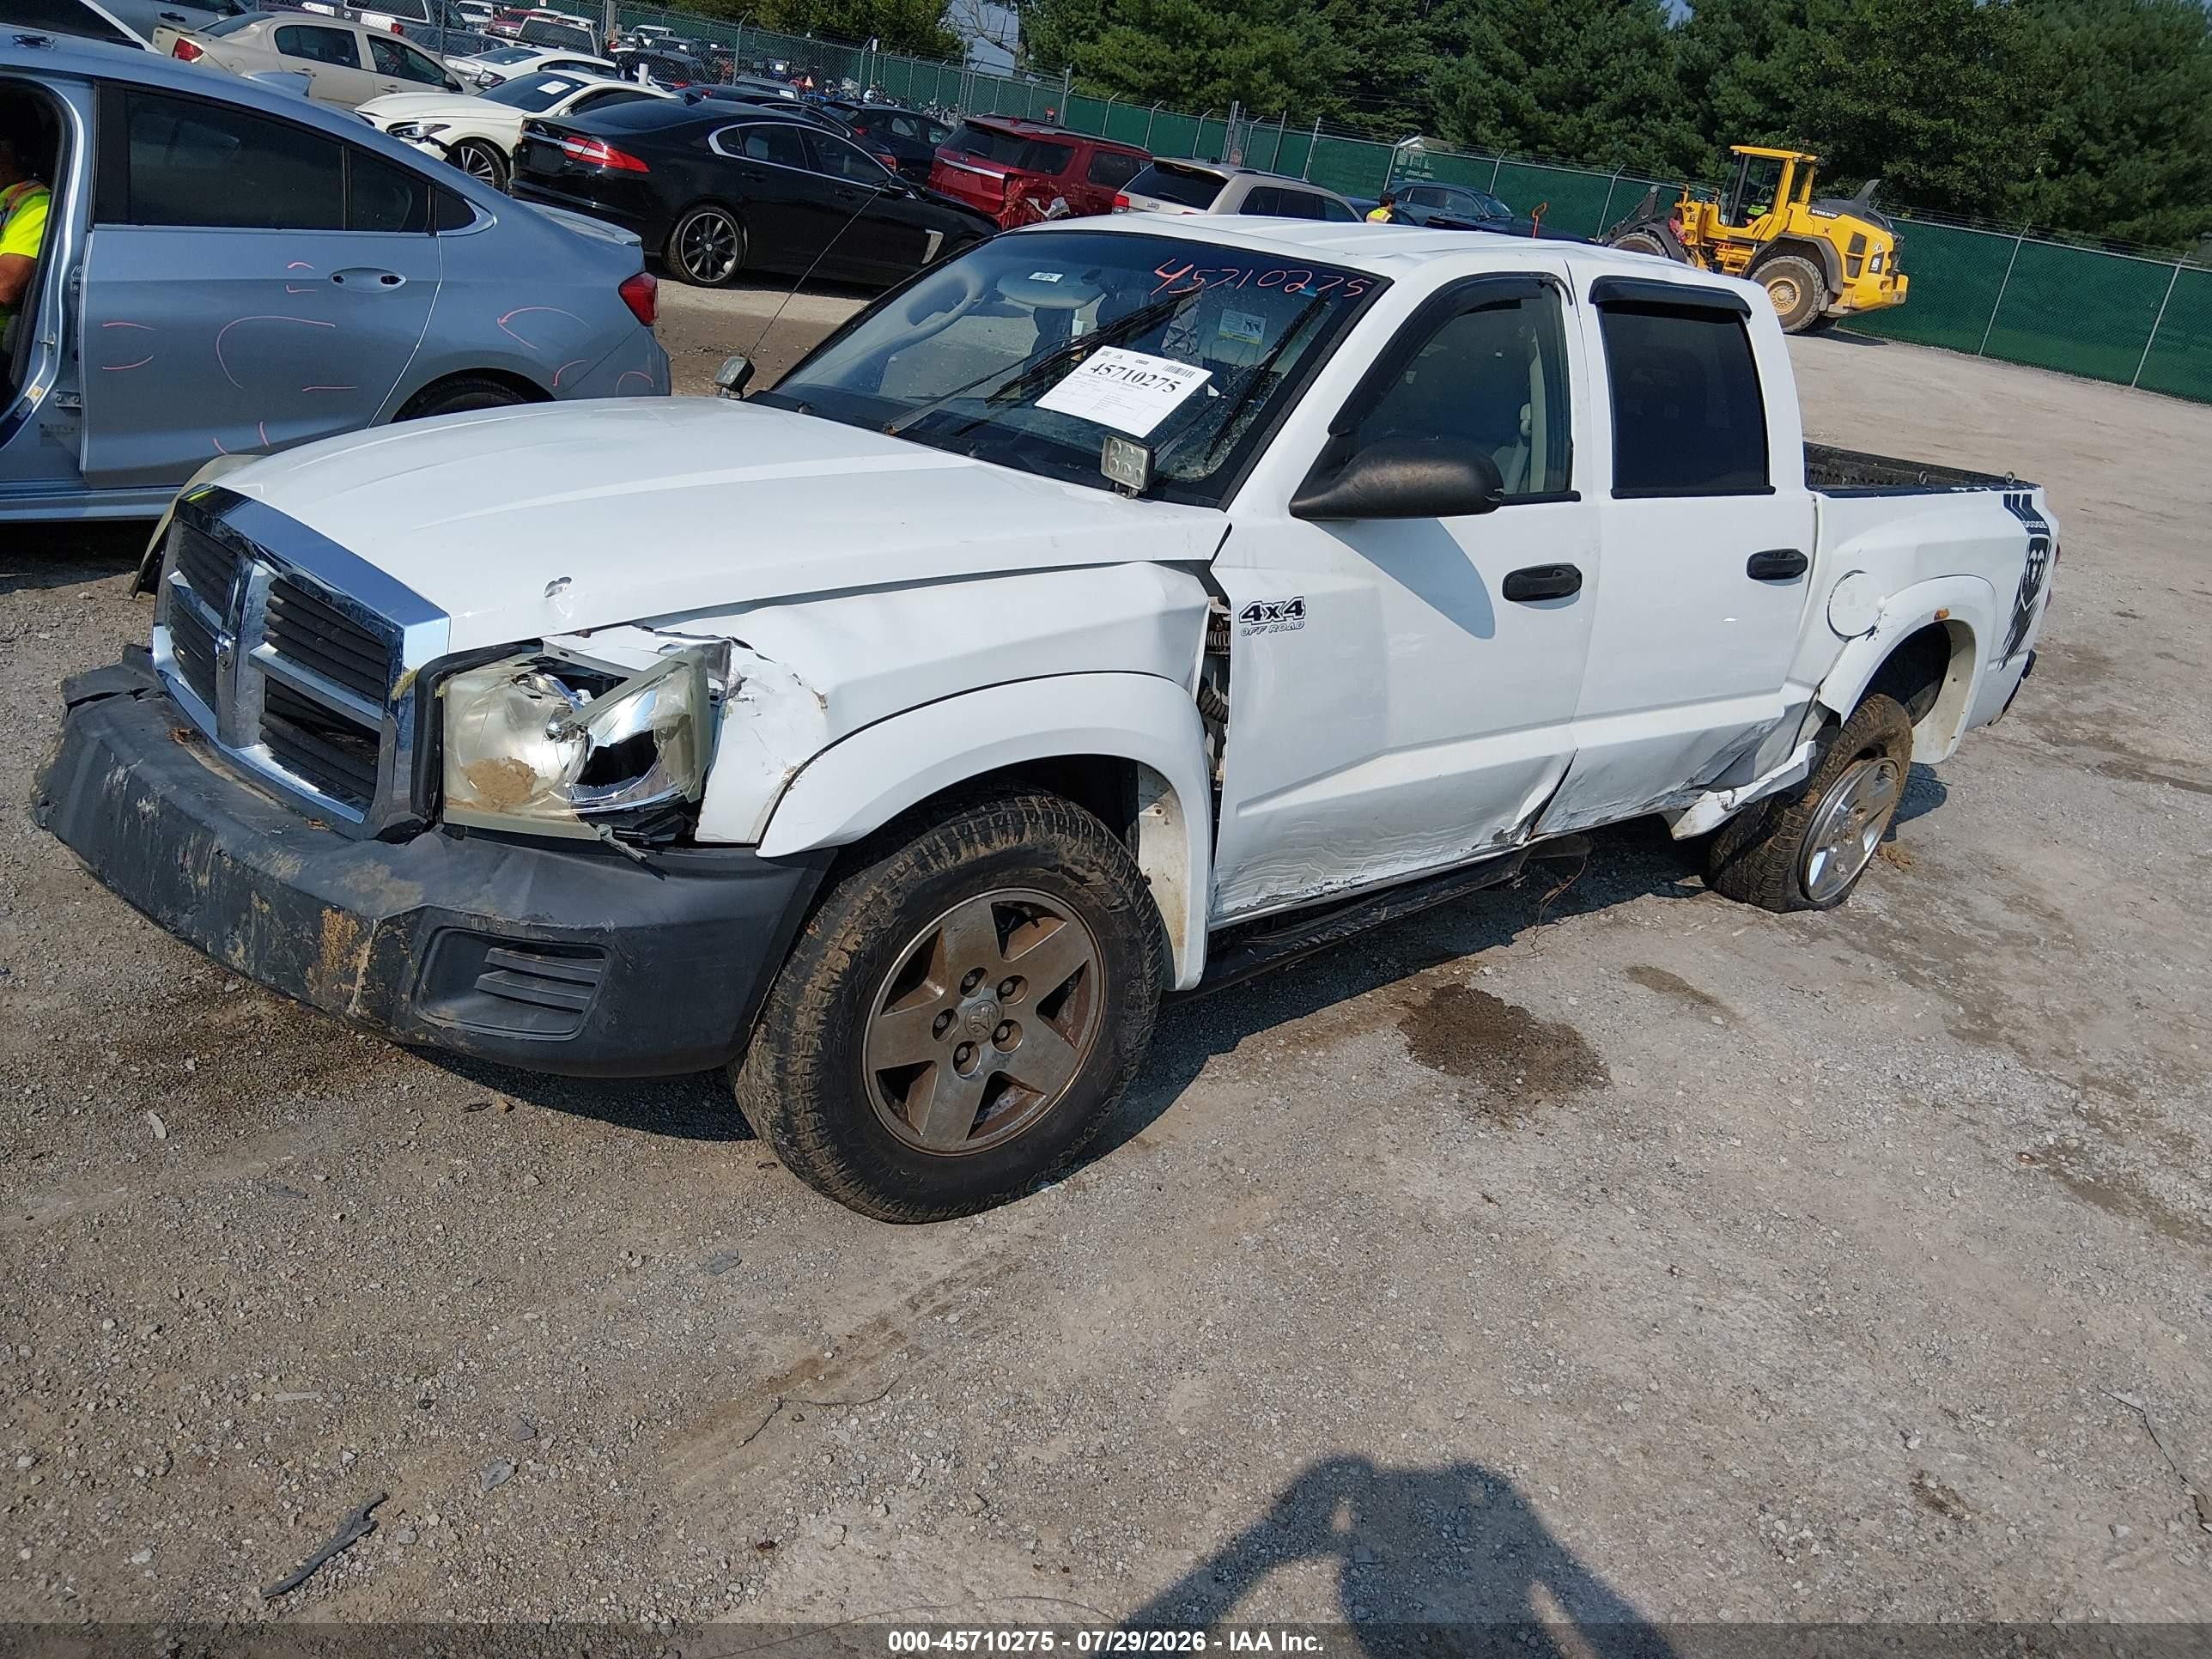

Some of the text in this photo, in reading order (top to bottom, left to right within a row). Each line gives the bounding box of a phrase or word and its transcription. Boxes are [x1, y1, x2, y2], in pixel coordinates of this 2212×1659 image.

[1812, 209, 1838, 218] VOLVO
[1149, 258, 1374, 298] 45710275
[1090, 362, 1182, 393] 45710275
[1239, 596, 1305, 625] 4x4
[1241, 621, 1305, 636] OFF ROAD
